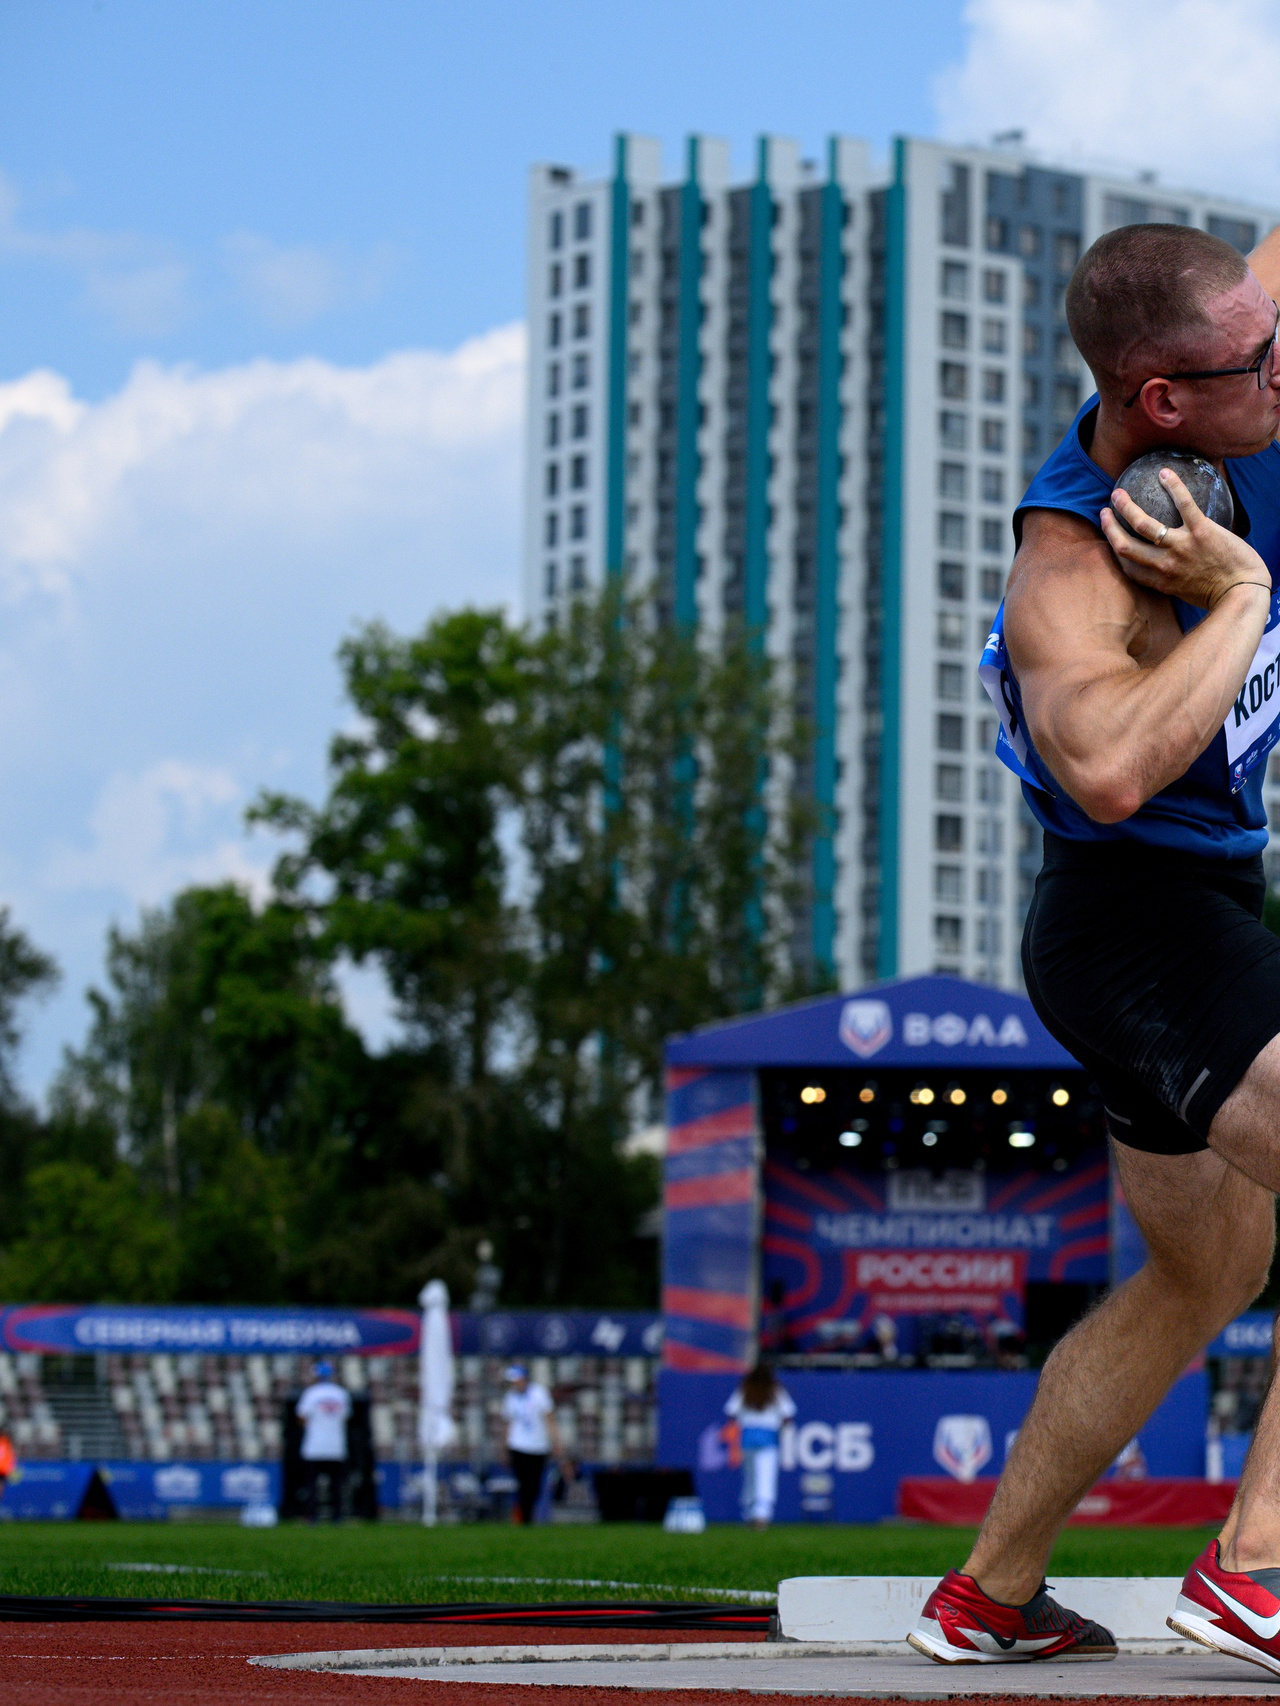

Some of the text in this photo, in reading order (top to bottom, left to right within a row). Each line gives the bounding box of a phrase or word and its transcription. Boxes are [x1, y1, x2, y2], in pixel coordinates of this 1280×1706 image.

[902, 1011, 1028, 1047] ВФЛА
[816, 1213, 1054, 1246] ЧЕМПИОНАТ
[858, 1255, 1013, 1288] РОССИИ
[74, 1317, 361, 1346] СЕВЕРНАЯ ТРИБУНА
